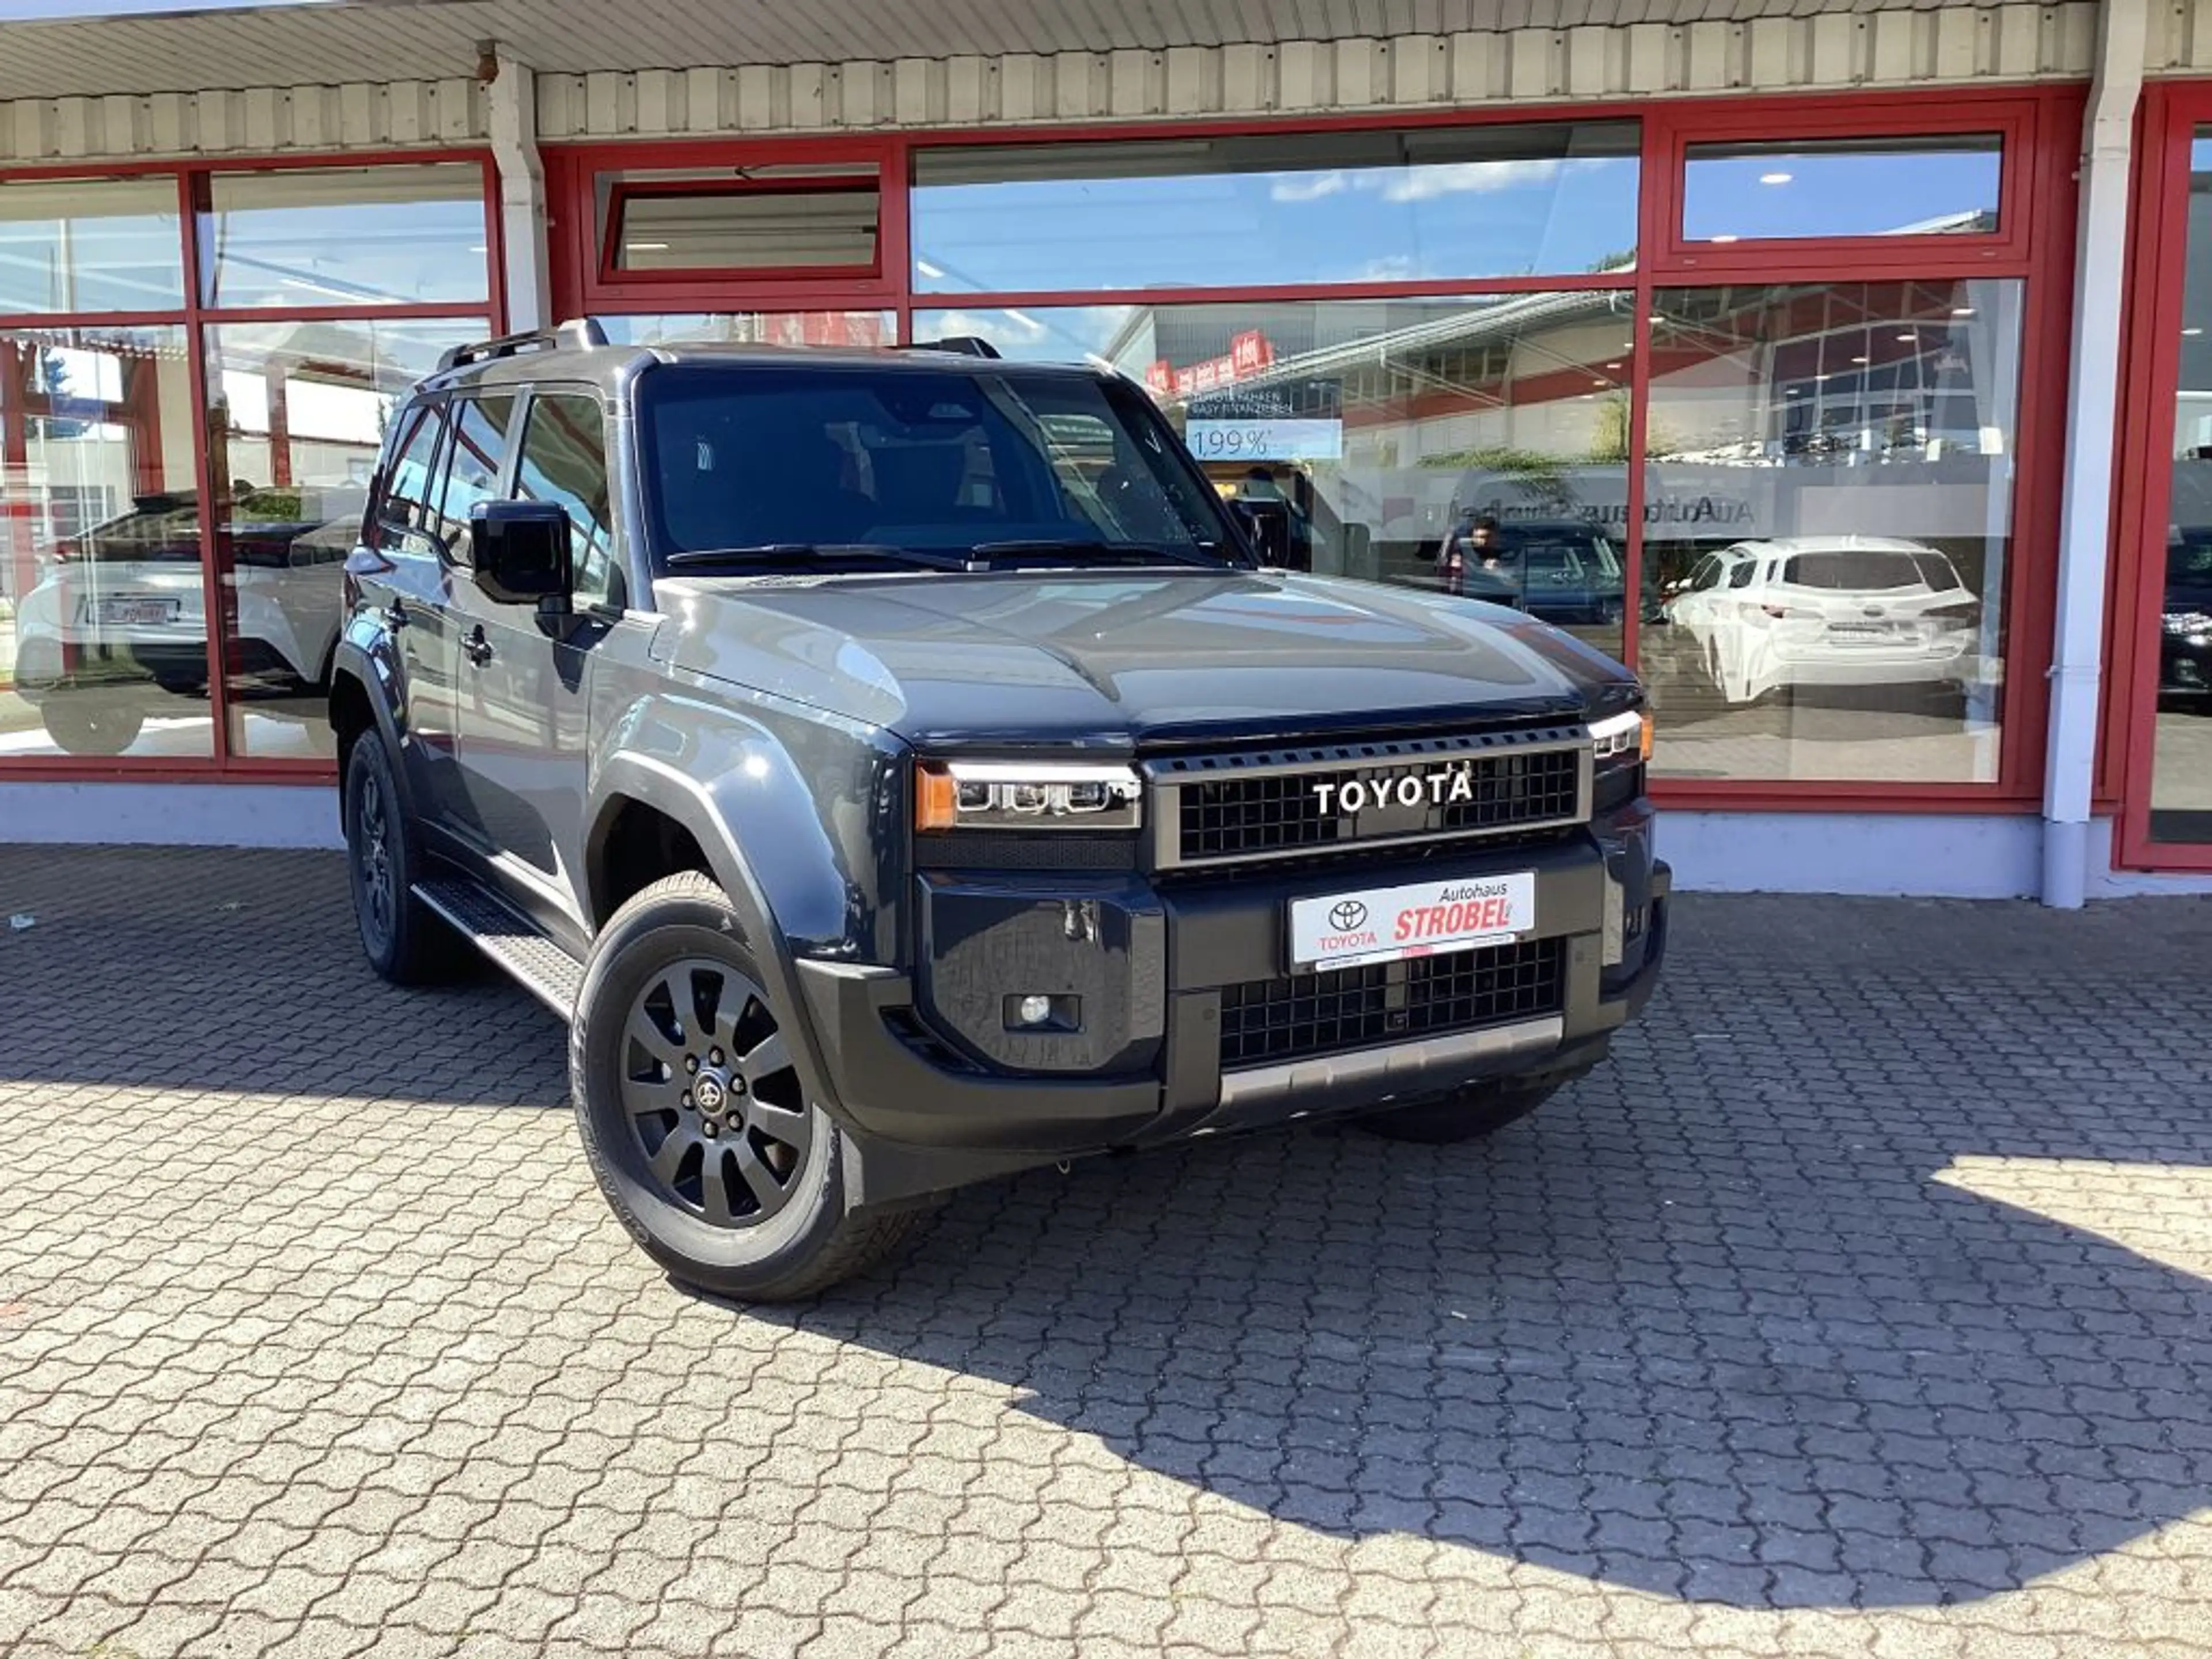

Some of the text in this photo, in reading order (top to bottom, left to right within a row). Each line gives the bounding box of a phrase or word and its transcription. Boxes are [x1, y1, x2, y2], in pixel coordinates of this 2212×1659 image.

[1313, 771, 1473, 814] TOYOTA
[1439, 882, 1508, 903] Autohaus
[1394, 899, 1510, 941] STROBEL
[1319, 931, 1377, 951] TOYOTA
